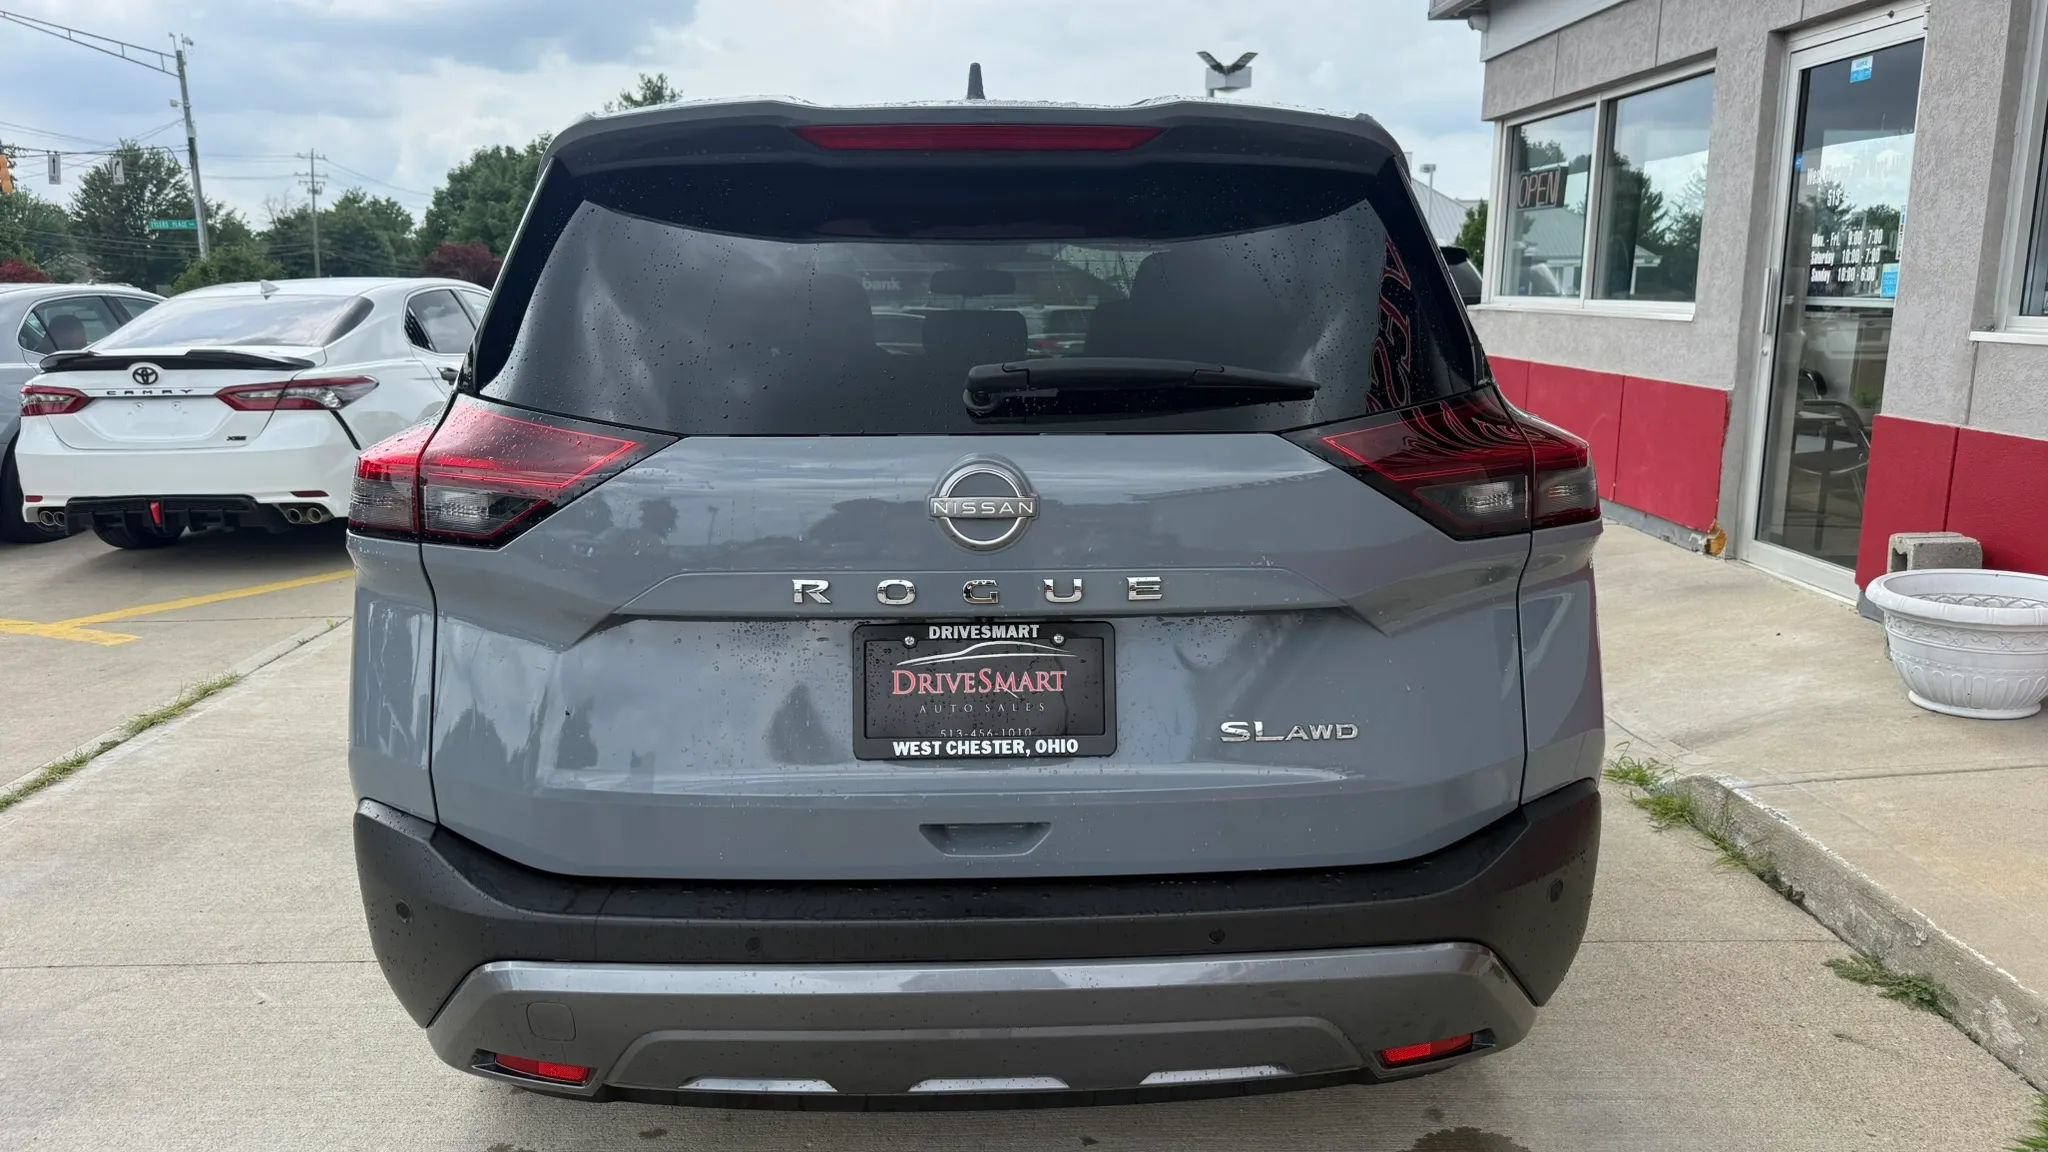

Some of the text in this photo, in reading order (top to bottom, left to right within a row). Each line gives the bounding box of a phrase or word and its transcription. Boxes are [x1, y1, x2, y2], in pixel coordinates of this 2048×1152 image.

[1518, 171, 1559, 207] OPEN
[1867, 228, 1883, 244] 7:00
[1810, 250, 1835, 266] Saturday
[1841, 248, 1860, 264] 10:00
[1865, 247, 1881, 263] 7:00
[862, 275, 901, 291] bank
[1811, 267, 1831, 284] Sunday
[1838, 266, 1856, 282] 10:00
[1860, 266, 1876, 281] 6:00
[933, 501, 1033, 514] NISSAN
[791, 576, 1164, 606] ROGUE
[928, 624, 1040, 640] DRIVESMART
[919, 702, 1045, 714] AUTO SALES
[940, 727, 1032, 737] 513-456-1010
[892, 739, 1079, 756] WEST CHESTER, OHIO
